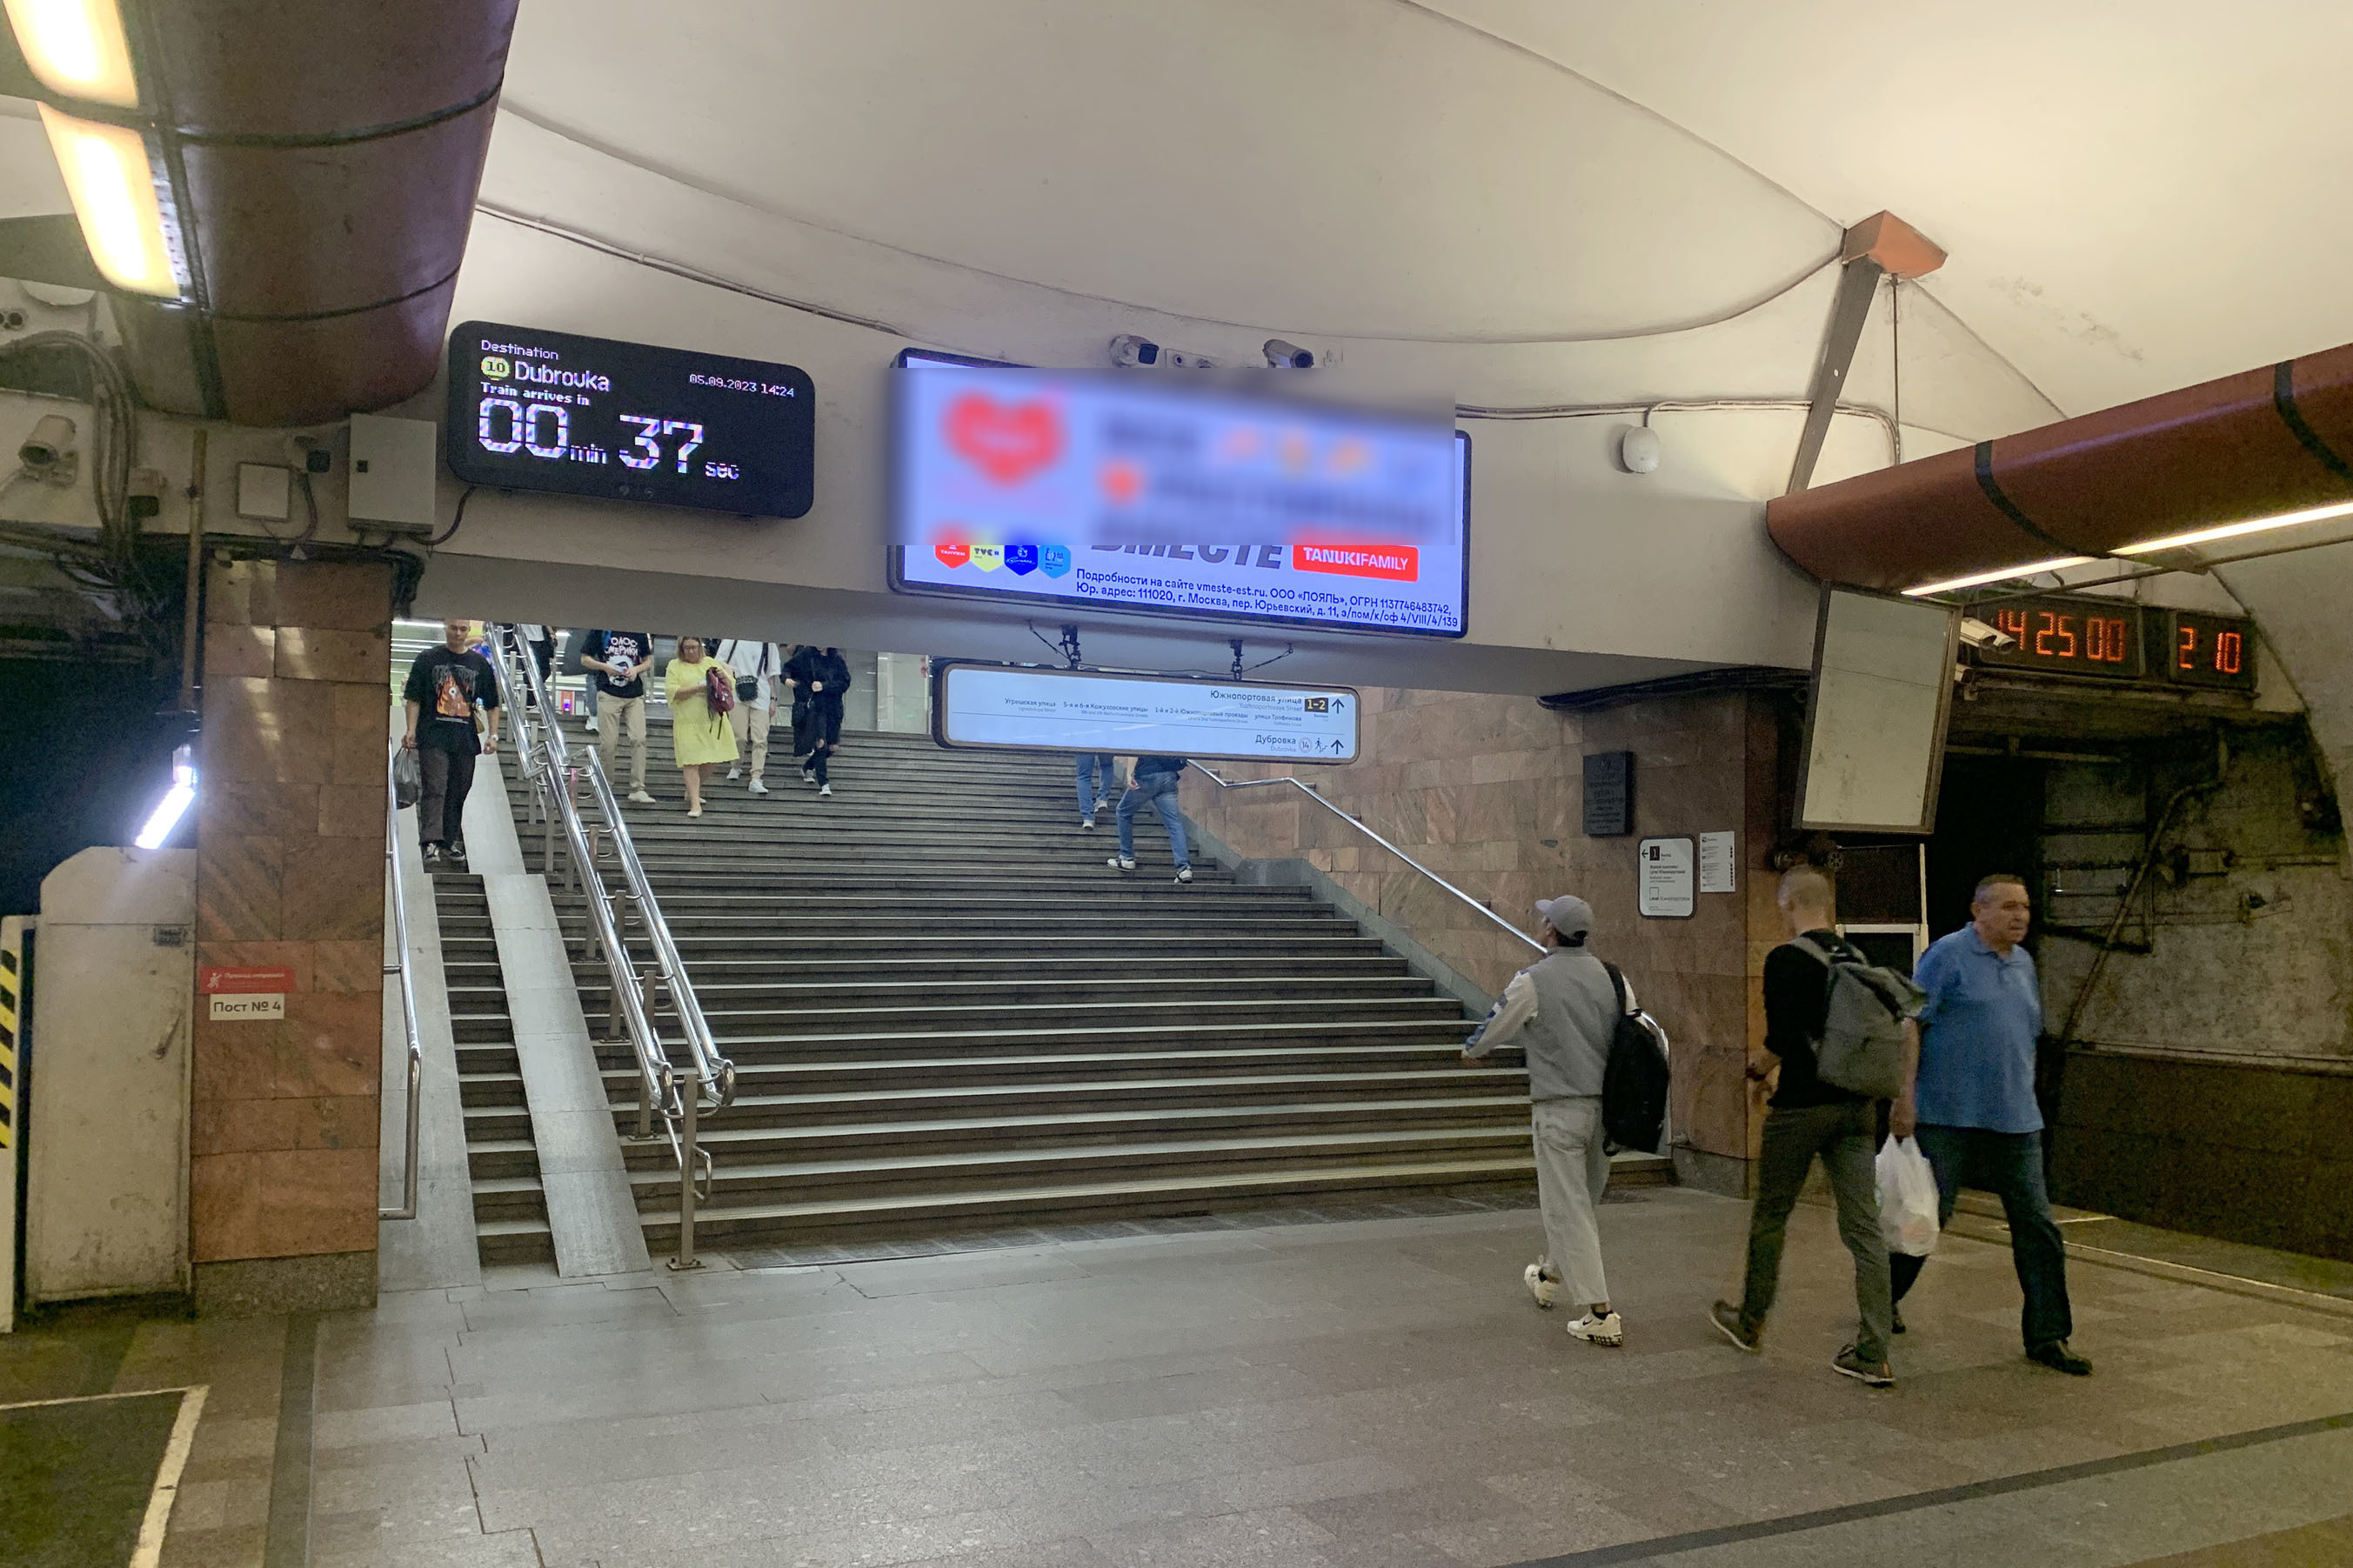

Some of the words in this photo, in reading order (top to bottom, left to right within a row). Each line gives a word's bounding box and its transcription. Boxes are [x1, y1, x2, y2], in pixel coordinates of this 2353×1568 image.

[481, 339, 559, 359] Destination
[486, 361, 505, 372] 10
[480, 382, 518, 397] Train
[523, 390, 572, 404] arrives
[577, 394, 590, 405] in
[689, 374, 757, 393] 05.09.2023
[760, 383, 794, 397] 14:24
[478, 397, 568, 459] 00
[570, 444, 607, 464] min
[618, 414, 704, 474] 37
[705, 462, 739, 480] sec
[1303, 547, 1409, 570] TANUKIFAMILY
[1076, 568, 1148, 585] Подробности
[1150, 578, 1162, 587] на
[1165, 578, 1194, 591] сайте
[1197, 583, 1268, 597] vmeste-est.ru.
[1270, 588, 1295, 599] ООО
[1349, 596, 1378, 608] ОГРН
[1380, 599, 1452, 616] 1137746483742,
[1076, 582, 1099, 596] Юр.
[1101, 587, 1136, 598] адрес:
[1138, 588, 1175, 603] 111020,
[1188, 593, 1230, 608] Москва,
[1232, 601, 1253, 611] пер.
[1255, 599, 1315, 616] Юрьевский,
[1317, 608, 1326, 617] д.
[1327, 607, 1340, 618] 11,
[1400, 612, 1458, 627] 4/VIII/4/139
[2036, 612, 2076, 657] 25
[2087, 617, 2126, 663] 00
[2179, 627, 2197, 670] 2
[2216, 632, 2242, 674] 10
[1210, 690, 1275, 703] Южнопортовая
[1277, 696, 1302, 705] улица
[1255, 735, 1296, 745] Дубровка
[214, 1002, 247, 1012] Пост
[251, 1001, 269, 1011] №
[272, 1002, 281, 1011] 4
